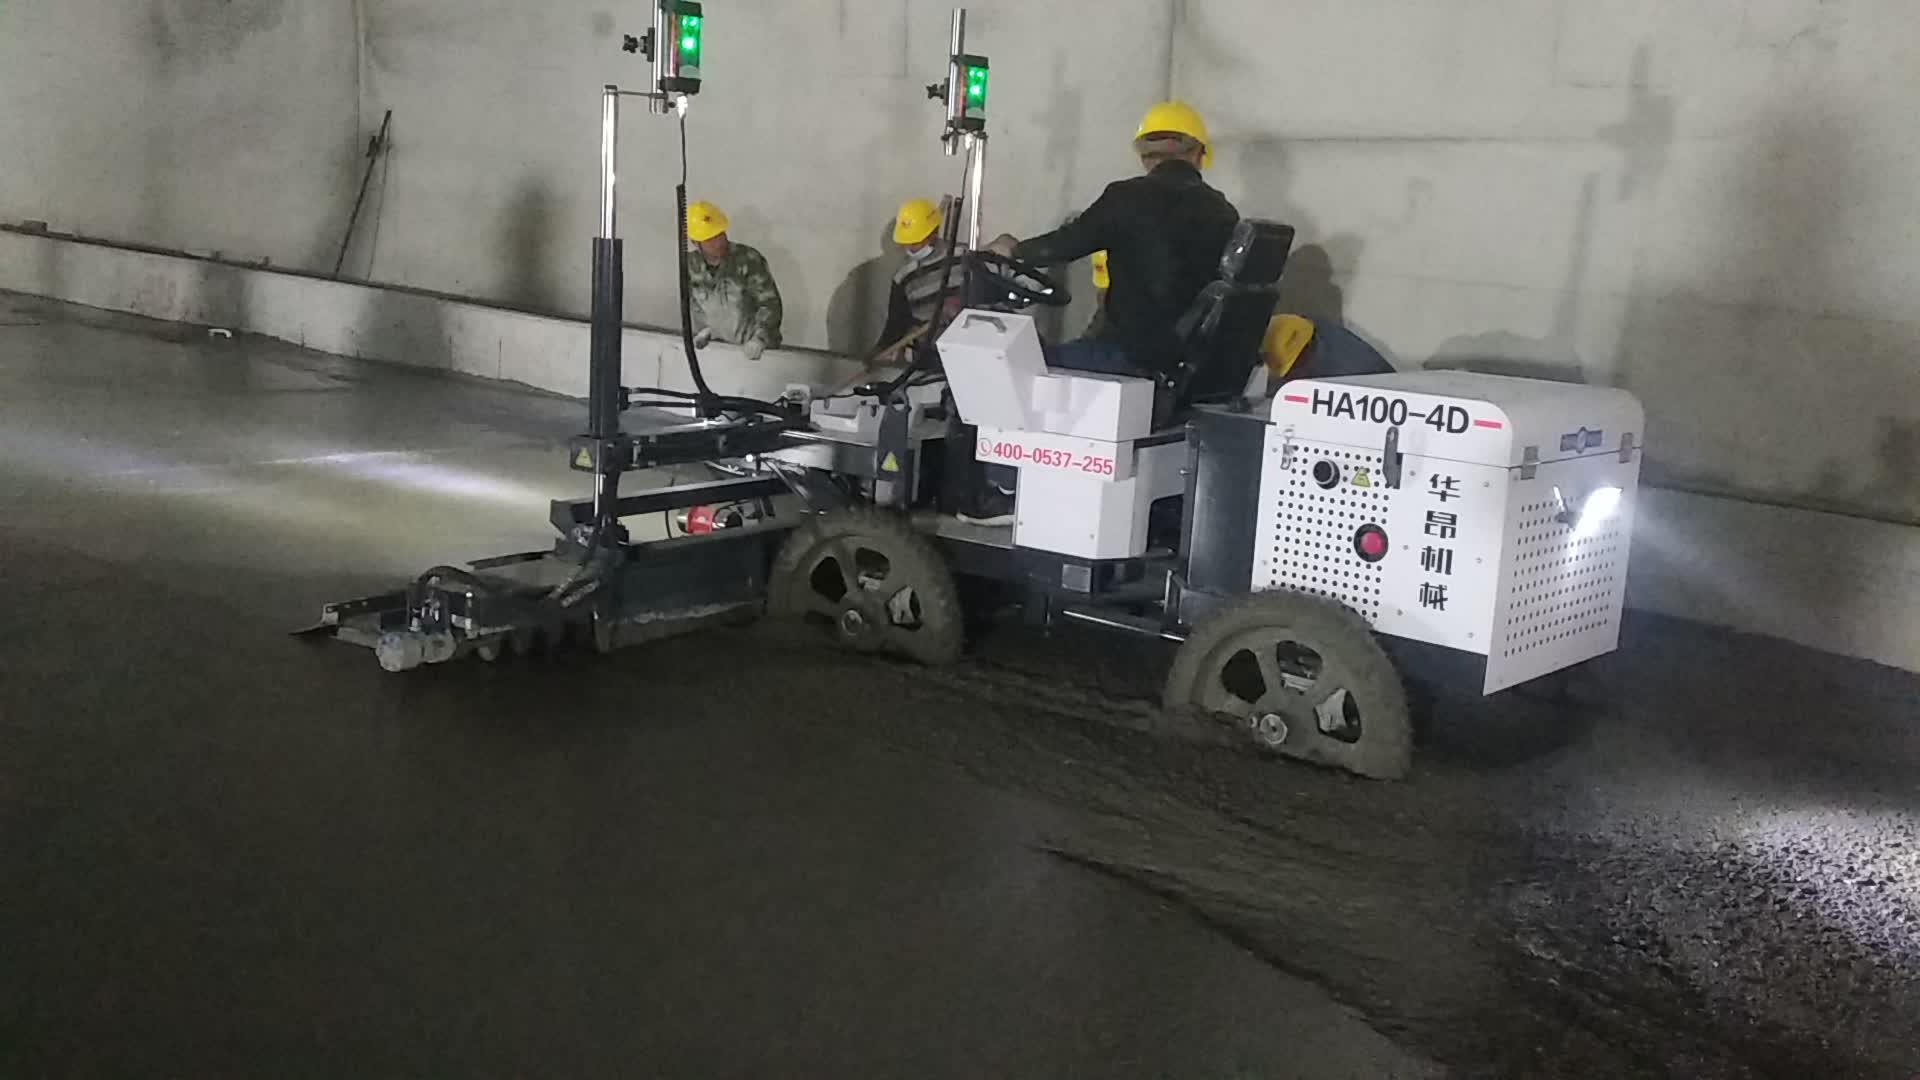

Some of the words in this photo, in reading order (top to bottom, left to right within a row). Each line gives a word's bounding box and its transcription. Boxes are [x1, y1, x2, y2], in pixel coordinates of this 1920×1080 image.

[1311, 388, 1469, 434] HA100-4D
[993, 442, 1113, 475] 400-0537-255
[1418, 473, 1462, 612] 华昂机械
